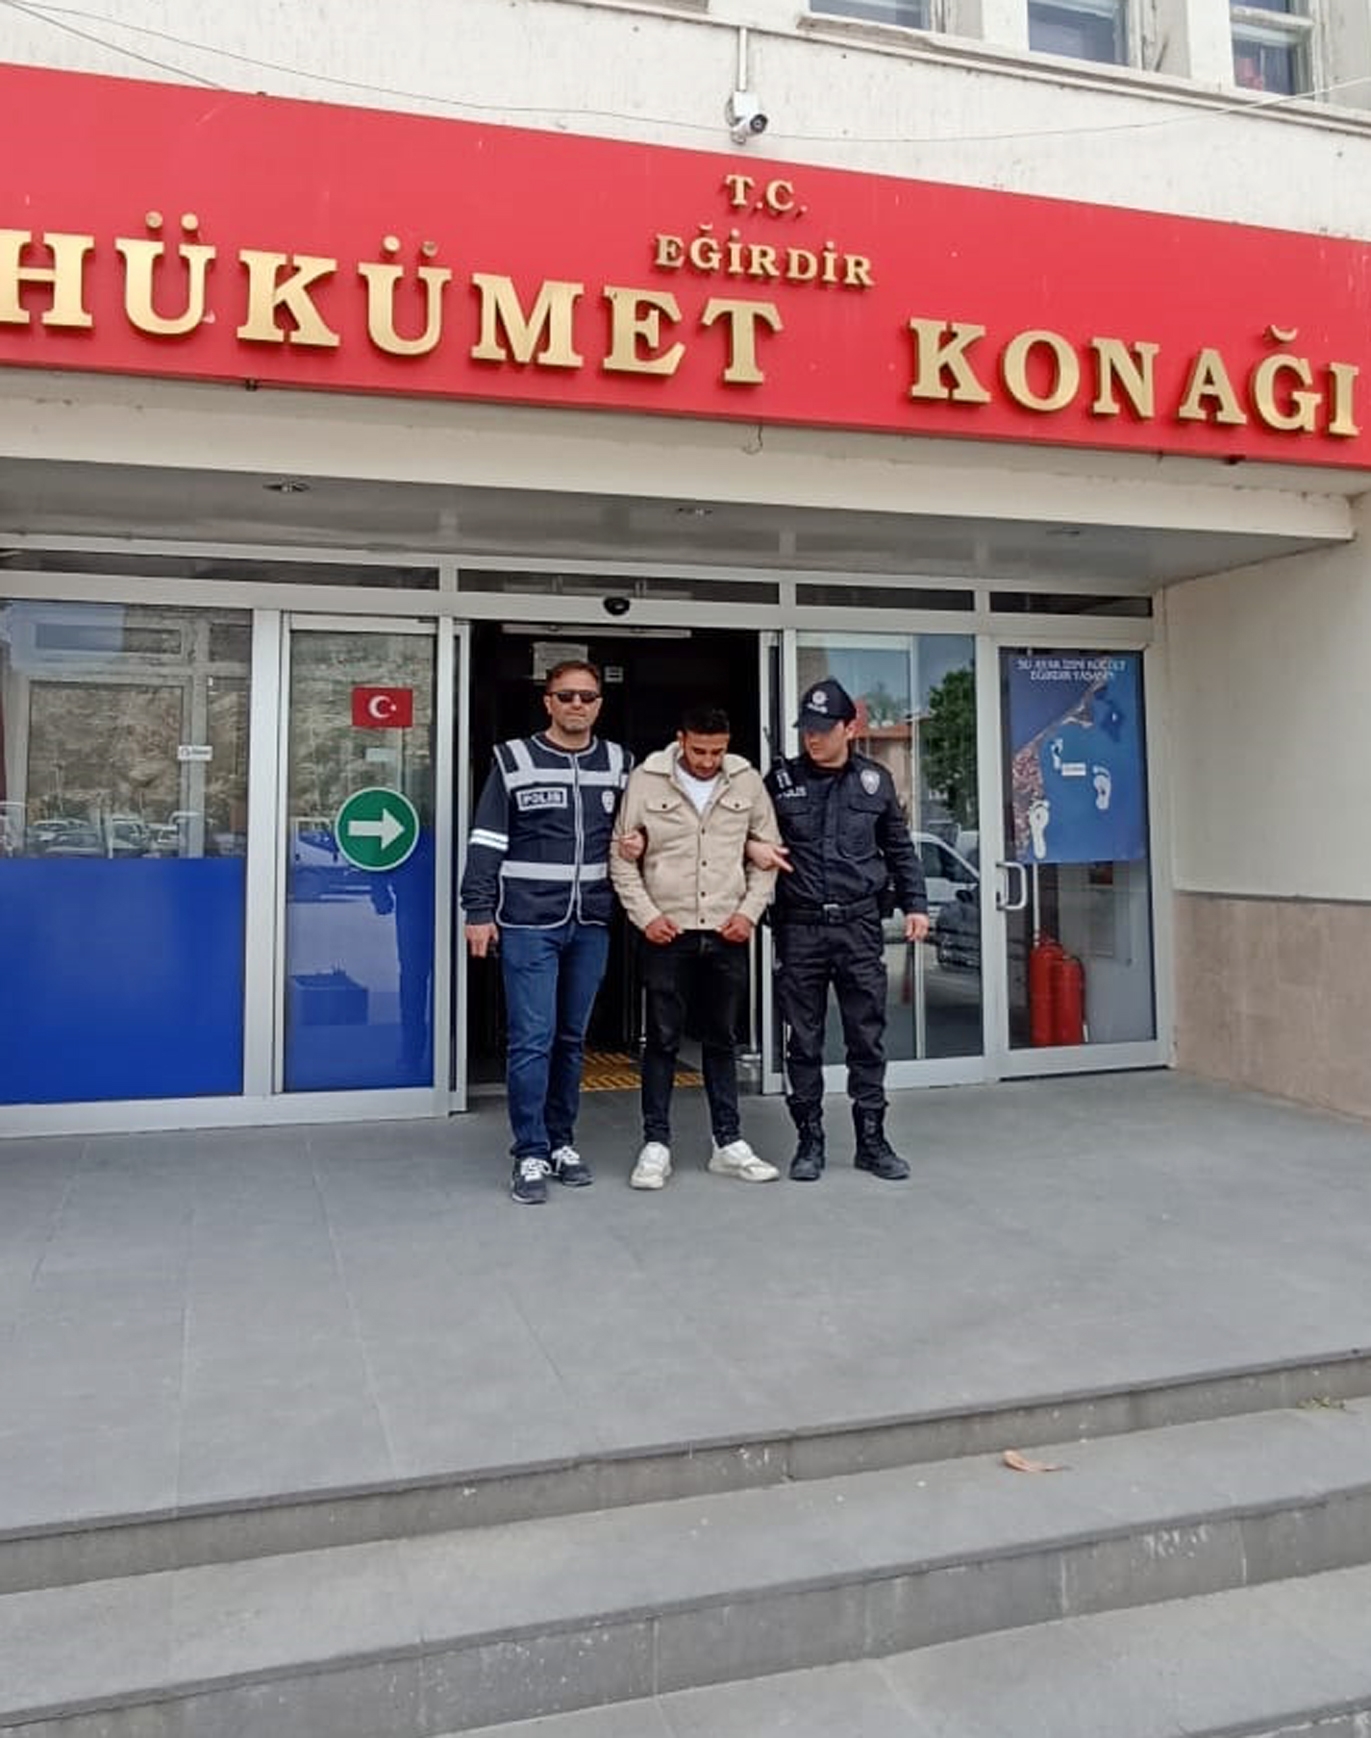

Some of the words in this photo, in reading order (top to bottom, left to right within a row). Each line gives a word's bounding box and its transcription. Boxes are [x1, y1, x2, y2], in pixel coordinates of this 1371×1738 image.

[724, 174, 808, 213] T.C.
[654, 224, 875, 287] EĞİRDİR
[0, 211, 784, 384] HÜKÜMET
[909, 317, 1360, 437] KONAĞI
